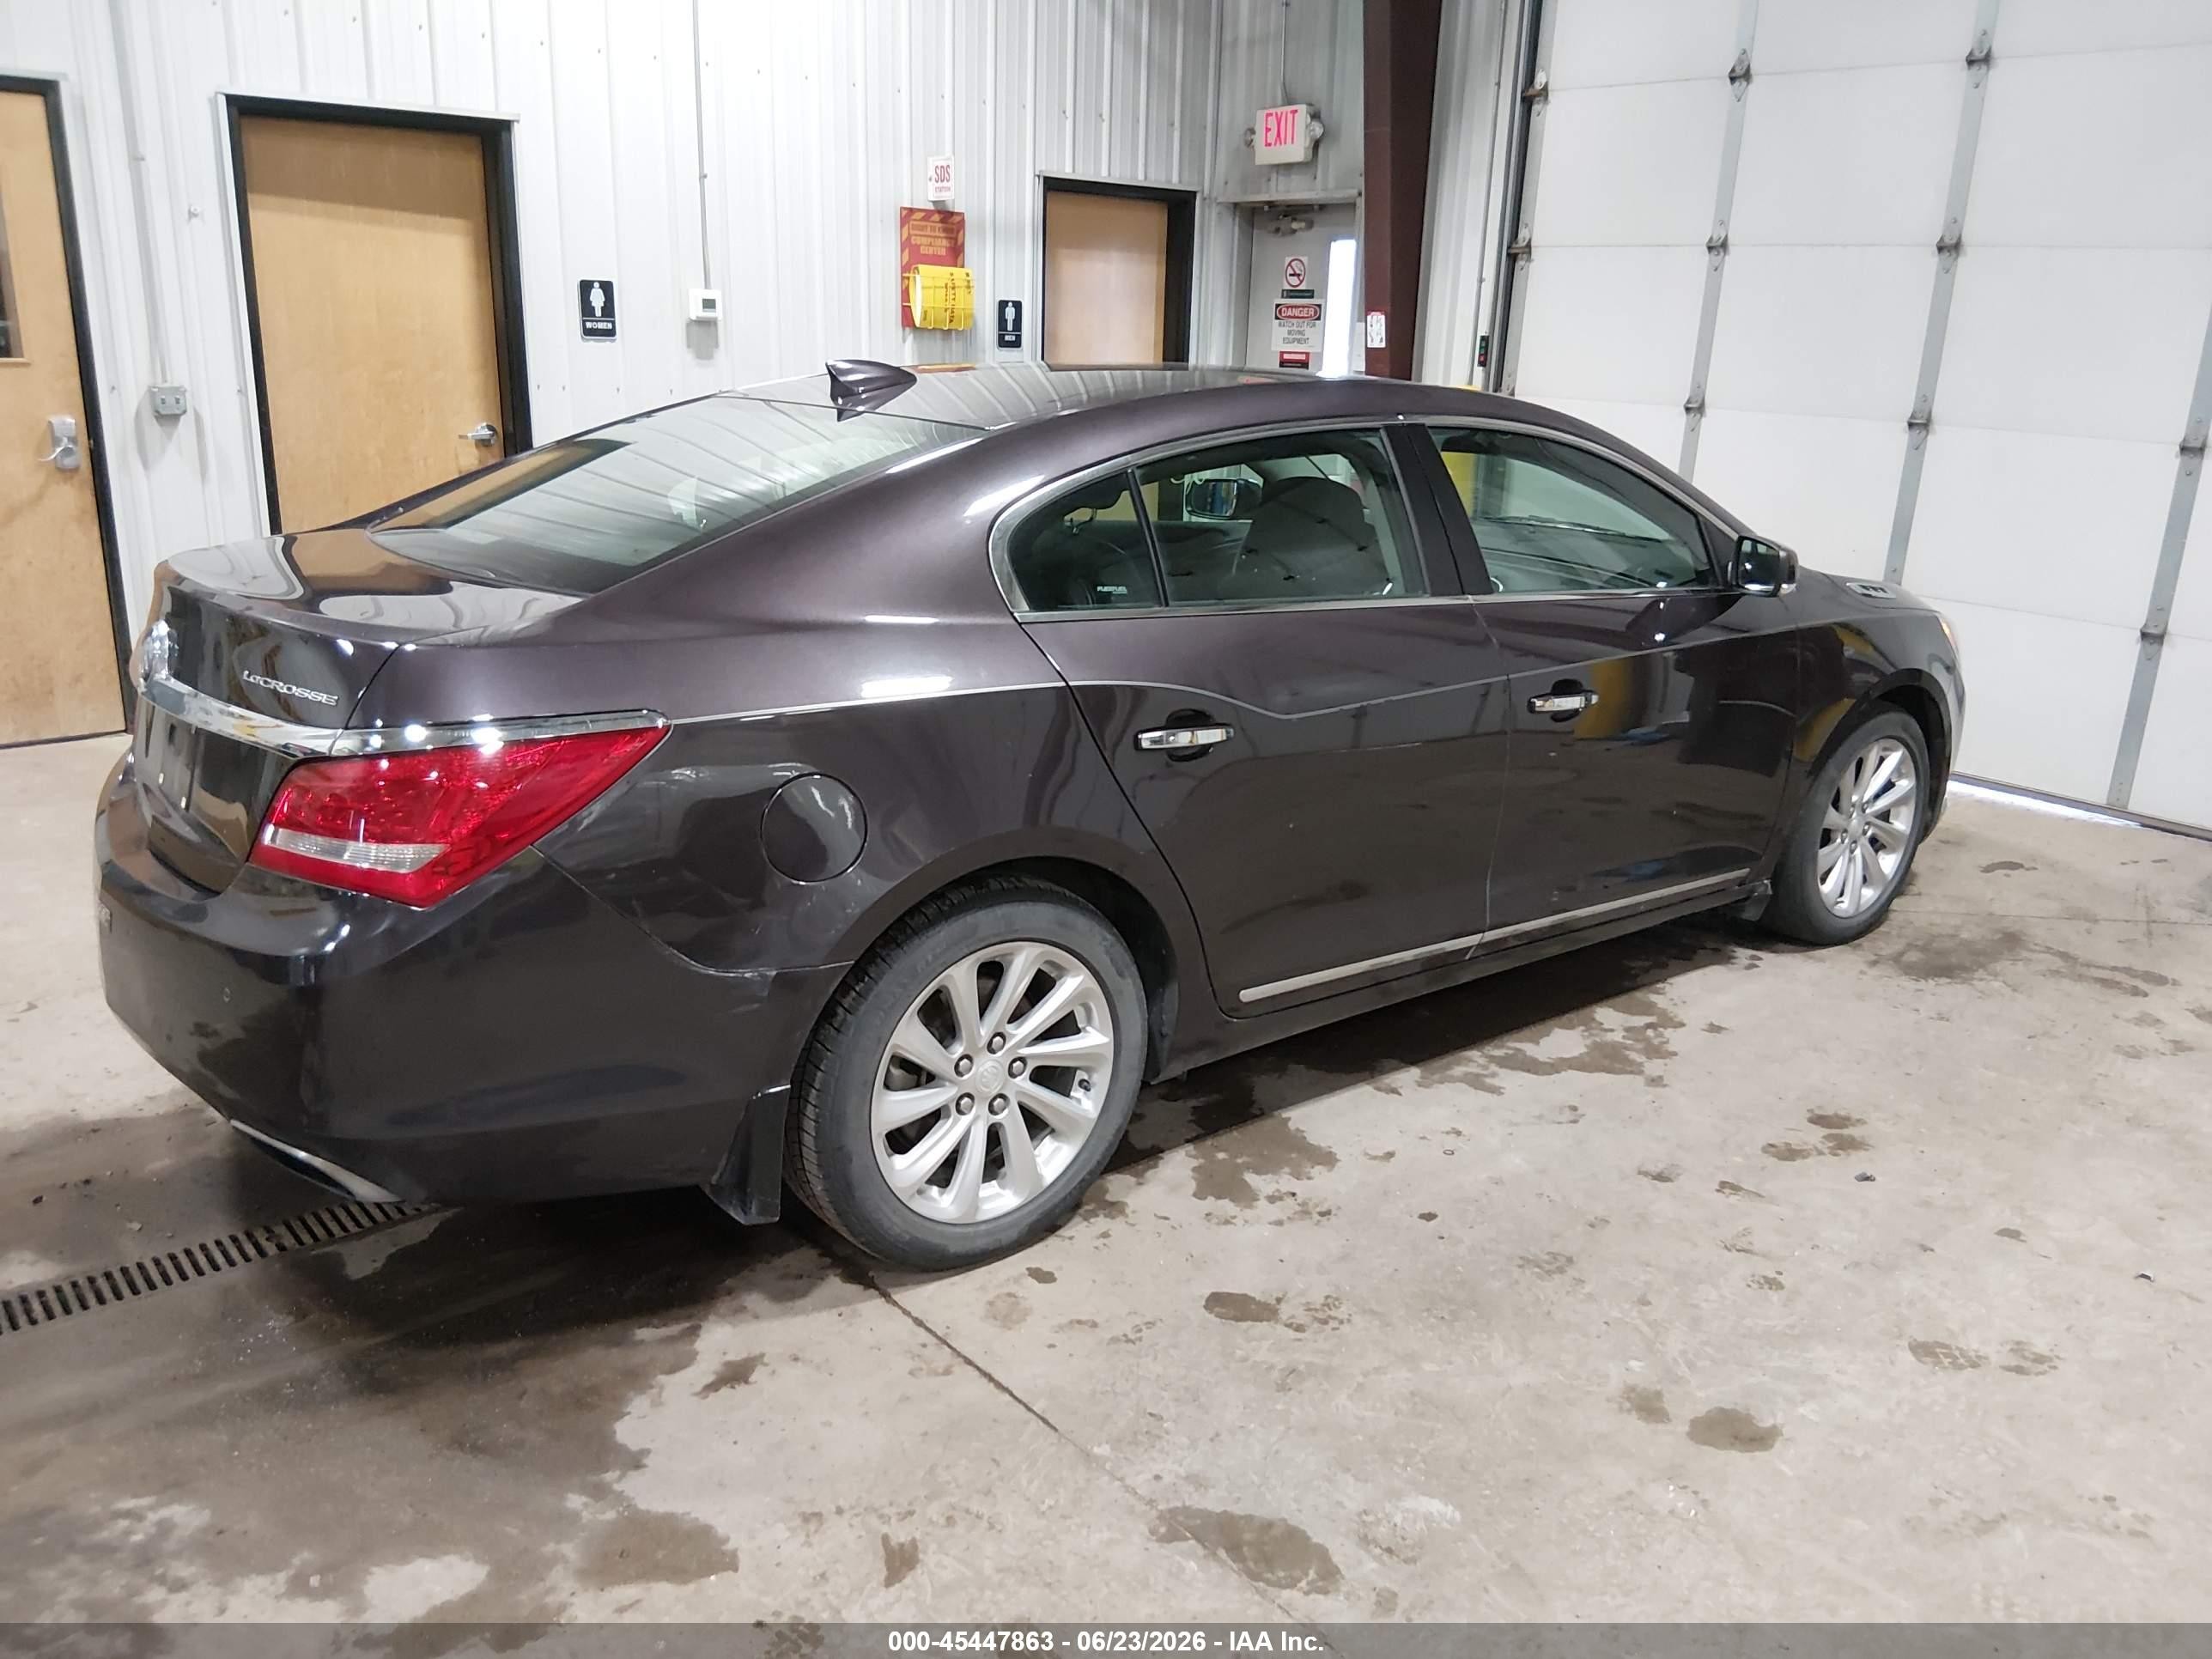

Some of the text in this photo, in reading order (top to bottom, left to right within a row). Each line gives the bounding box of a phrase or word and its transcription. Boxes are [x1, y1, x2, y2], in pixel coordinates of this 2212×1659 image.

[1264, 109, 1298, 148] EXIT
[934, 164, 951, 184] SDS
[920, 246, 946, 256] CENTER
[1281, 307, 1315, 318] DANGER
[585, 321, 613, 330] WOMEN
[1278, 320, 1295, 329] WATCH
[1306, 321, 1316, 330] FOR
